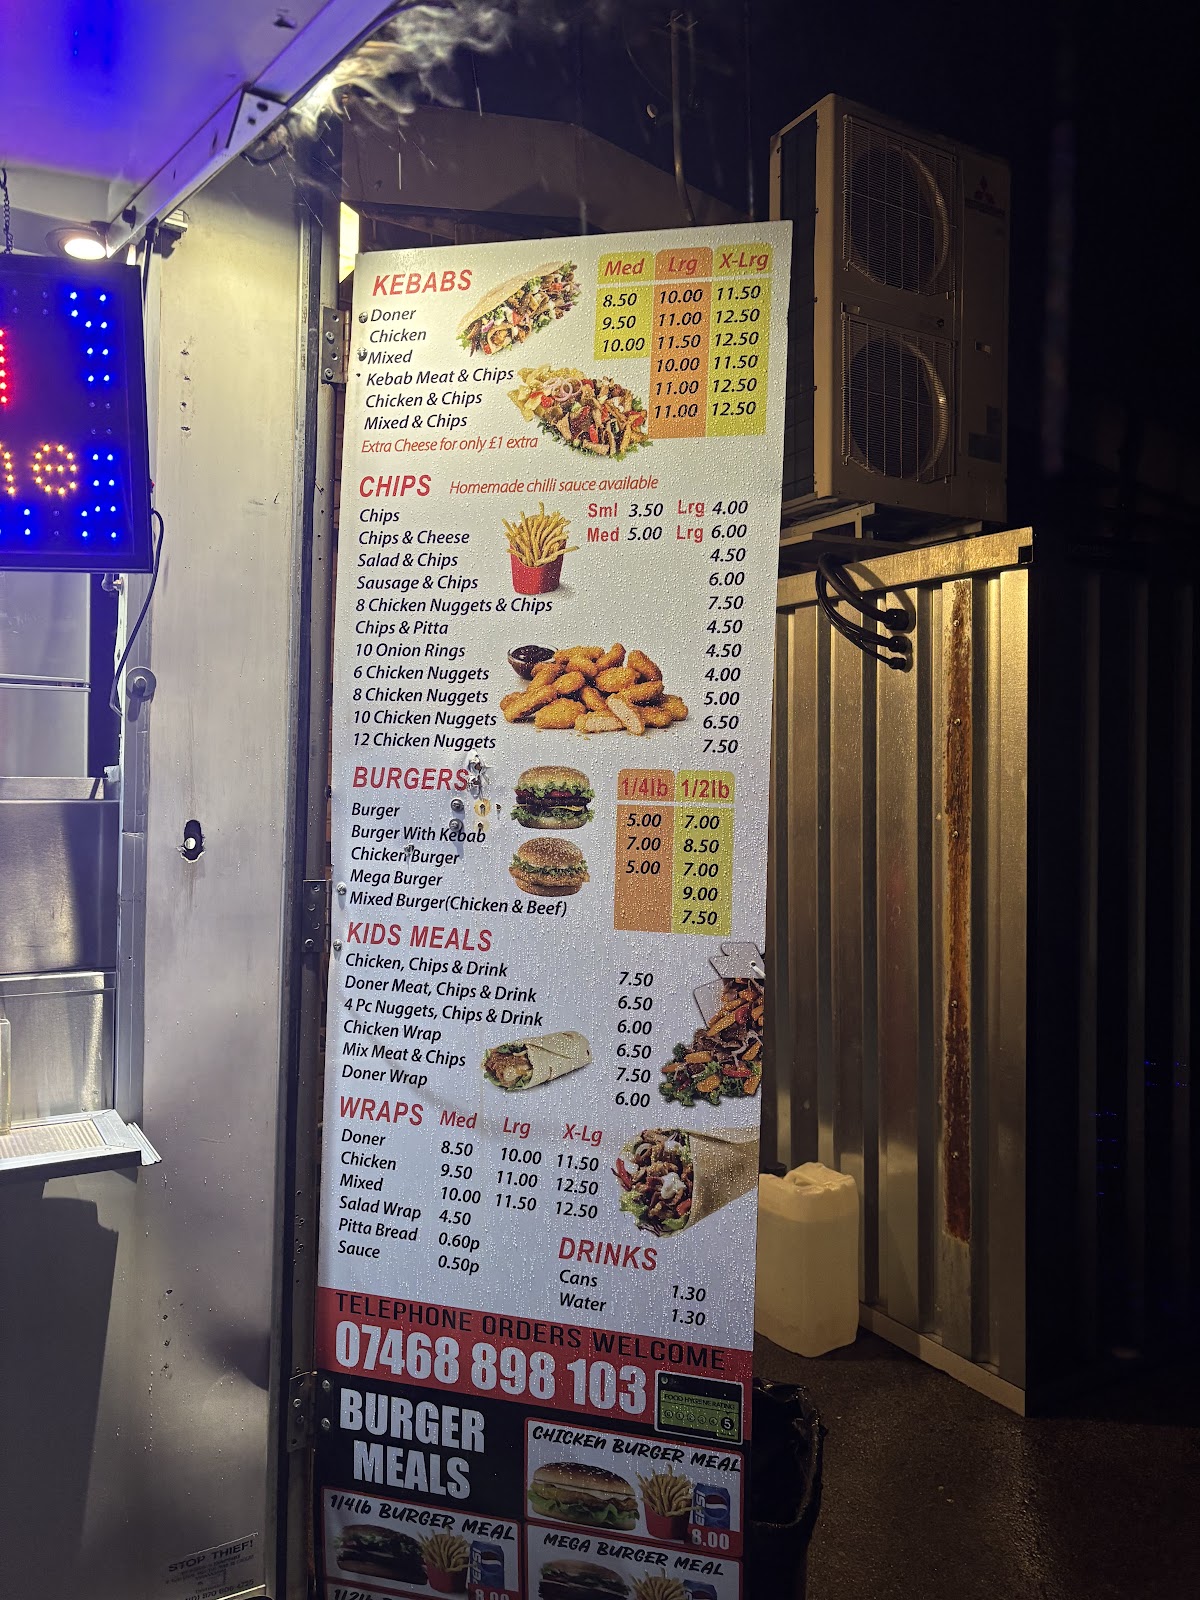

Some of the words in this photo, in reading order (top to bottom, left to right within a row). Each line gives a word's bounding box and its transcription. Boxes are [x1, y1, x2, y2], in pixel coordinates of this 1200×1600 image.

[604, 259, 645, 276] Med
[668, 254, 698, 274] Lrg
[719, 251, 769, 271] X-Lrg
[372, 269, 473, 296] KEBABS
[716, 285, 761, 300] 11.50
[371, 308, 417, 323] Doner
[715, 309, 760, 323] 12.50
[369, 328, 427, 343] Chicken
[714, 332, 759, 346] 12.50
[368, 350, 412, 364] Mixed
[367, 372, 413, 386] Kebab
[416, 371, 454, 384] Meat
[472, 367, 514, 385] Chips
[655, 381, 699, 396] 11.00
[366, 393, 422, 408] Chicken
[440, 390, 483, 408] Chips
[364, 416, 408, 430] Mixed
[427, 414, 468, 432] Chips
[362, 440, 395, 453] Extra
[395, 439, 438, 452] Cheese
[440, 438, 458, 452] for
[460, 437, 486, 454] only
[489, 436, 503, 449] £1
[506, 436, 538, 449] extra
[359, 475, 432, 497] CHIPS
[450, 479, 524, 494] Homemade
[526, 478, 556, 492] chilli
[559, 480, 596, 492] sauce
[599, 475, 659, 491] available
[359, 508, 400, 525] Chips
[588, 502, 618, 518] Sml
[629, 502, 663, 518] 3.50
[677, 500, 705, 519] Lrg
[712, 500, 749, 516] 4.00
[359, 530, 398, 547] Chips
[417, 530, 470, 545] Cheese
[587, 527, 619, 543] Med
[627, 526, 662, 541] 5.00
[677, 525, 704, 543] Lrg
[711, 524, 748, 539] 6.00
[358, 553, 397, 567] Salad
[416, 552, 459, 570] Chips
[710, 548, 746, 563] 4.50
[357, 576, 419, 592] Sausage
[437, 575, 478, 592] Chips
[369, 599, 426, 612] Chicken
[430, 599, 492, 615] Nuggets
[511, 598, 553, 615] Chips
[355, 621, 396, 638] Chips
[414, 621, 449, 635] Pitta
[706, 620, 743, 634] 4.50
[356, 644, 373, 656] 10
[377, 644, 420, 657] Onion
[424, 644, 466, 661] Rings
[366, 666, 424, 680] Chicken
[428, 667, 490, 683] Nuggets
[366, 689, 423, 703] Chicken
[427, 689, 489, 705] Nuggets
[703, 691, 740, 706] 5.00
[354, 711, 370, 724] 10
[374, 711, 432, 726] Chicken
[435, 712, 497, 728] Nuggets
[353, 733, 370, 746] 12
[373, 733, 431, 748] Chicken
[434, 734, 496, 751] Nuggets
[353, 767, 469, 791] BURGERS
[622, 778, 668, 797] 1/4lb
[681, 778, 730, 799] 1/2lb
[352, 803, 400, 820] Burger
[626, 813, 662, 828] 5.00
[351, 826, 400, 842] Burger
[403, 826, 436, 840] With
[439, 828, 486, 843] Kebab
[351, 847, 408, 862] Chicken
[411, 849, 459, 866] Burger
[626, 860, 661, 875] 5.00
[350, 870, 392, 886] Mega
[395, 871, 443, 887] Burger
[349, 892, 395, 906] Mixed
[398, 893, 508, 914] Burger(Chicken
[527, 900, 568, 918] Beef)
[682, 910, 717, 925] 7.50
[347, 922, 401, 947] KIDS
[410, 926, 492, 952] MEALS
[345, 953, 404, 971] Chicken,
[408, 957, 449, 976] Chips
[467, 961, 508, 977] Drink
[344, 975, 389, 992] Doner
[392, 978, 432, 996] Meat,
[436, 983, 477, 1001] Chips
[495, 987, 537, 1003] Drink
[356, 999, 373, 1013] Pc
[375, 1000, 439, 1020] Nuggets,
[442, 1006, 483, 1024] Chips
[500, 1010, 543, 1026] Drink
[343, 1020, 400, 1037] Chicken
[403, 1023, 442, 1042] Wrap
[617, 1020, 652, 1035] 6.00
[342, 1042, 369, 1057] Mix
[372, 1044, 408, 1061] Meat
[425, 1049, 466, 1067] Chips
[342, 1064, 387, 1081] Doner
[390, 1068, 428, 1087] Wrap
[339, 1096, 424, 1126] WRAPS
[440, 1110, 478, 1129] Med
[341, 1129, 386, 1146] Doner
[503, 1117, 531, 1139] Lrg
[563, 1123, 603, 1146] X-Lg
[441, 1140, 473, 1157] 8.50
[340, 1151, 397, 1171] Chicken
[440, 1164, 473, 1180] 9.50
[339, 1173, 383, 1192] Mixed
[440, 1186, 481, 1204] 10.00
[339, 1195, 380, 1213] Salad
[384, 1202, 421, 1220] Wrap
[439, 1209, 471, 1226] 4.50
[338, 1217, 372, 1235] Pitta
[375, 1222, 418, 1241] Bread
[338, 1240, 380, 1259] Sauce
[438, 1232, 480, 1252] 0.60p
[558, 1236, 658, 1271] DRINKS
[438, 1255, 480, 1275] 0.50p
[559, 1269, 598, 1287] Cans
[559, 1292, 607, 1313] Water
[337, 1292, 472, 1332] TELEPHONE
[482, 1315, 581, 1348] ORDERS
[593, 1331, 725, 1371] WELCOME
[336, 1321, 459, 1384] 07468
[471, 1341, 556, 1400] 898
[567, 1359, 646, 1415] 103
[664, 1394, 683, 1402] FOOD
[340, 1388, 485, 1453] BURGER
[612, 1439, 684, 1463] BURGER
[690, 1453, 742, 1472] MEAL
[353, 1440, 470, 1499] MEALS
[379, 1503, 455, 1530] BURGER
[462, 1519, 515, 1540] MEAL
[691, 1529, 729, 1550] 8.00
[169, 1556, 205, 1572] STOP
[211, 1540, 253, 1559] THIEF!
[543, 1533, 590, 1552] MEGA
[597, 1542, 668, 1567] BURGER
[674, 1557, 724, 1576] MEAL
